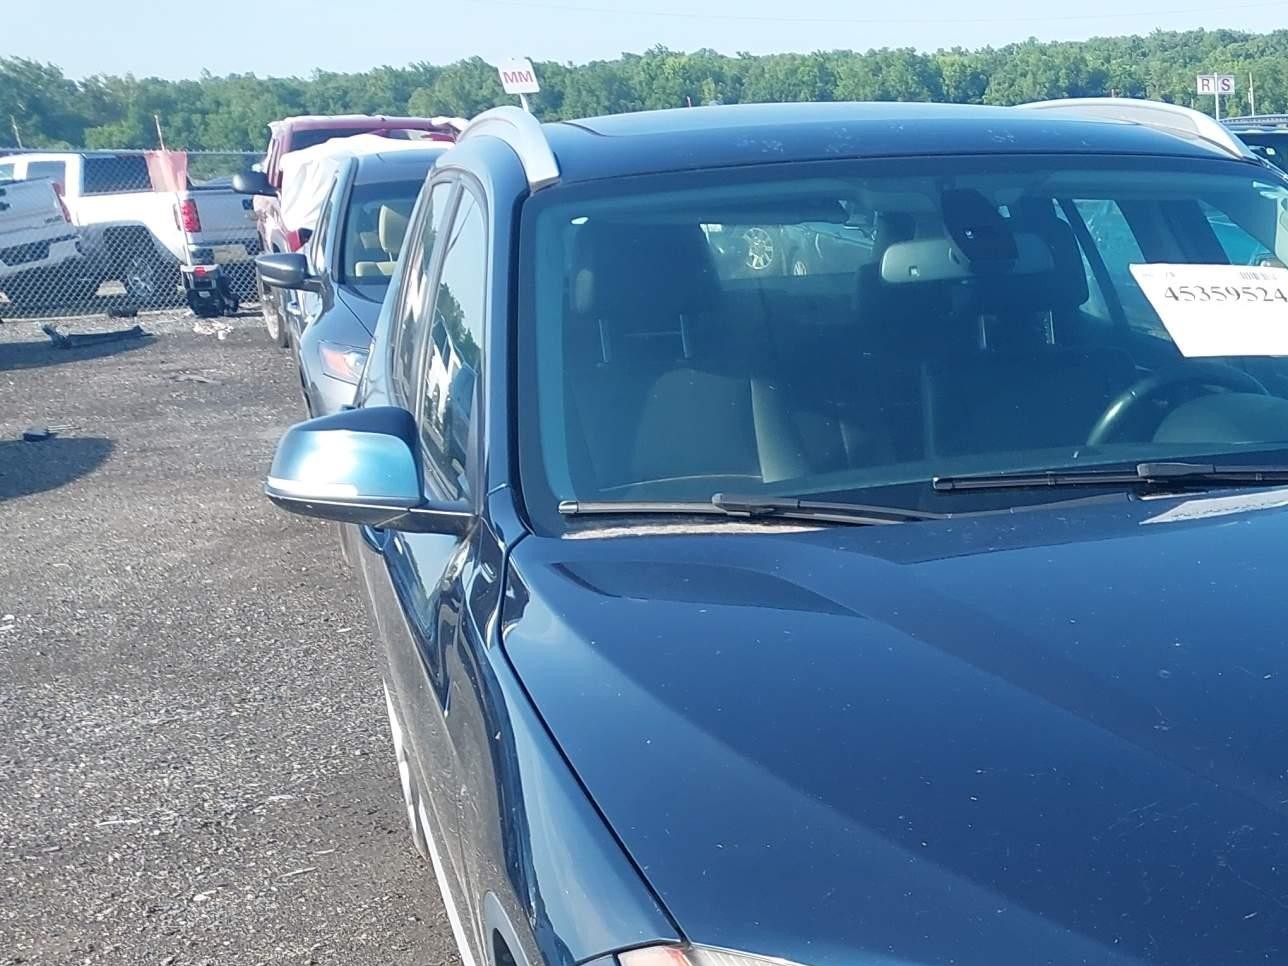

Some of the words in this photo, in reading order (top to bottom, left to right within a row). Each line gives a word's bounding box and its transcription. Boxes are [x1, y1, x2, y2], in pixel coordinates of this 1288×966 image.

[502, 70, 534, 84] MM
[1201, 78, 1210, 91] R
[1221, 78, 1231, 92] S
[1164, 285, 1288, 302] 45359524
